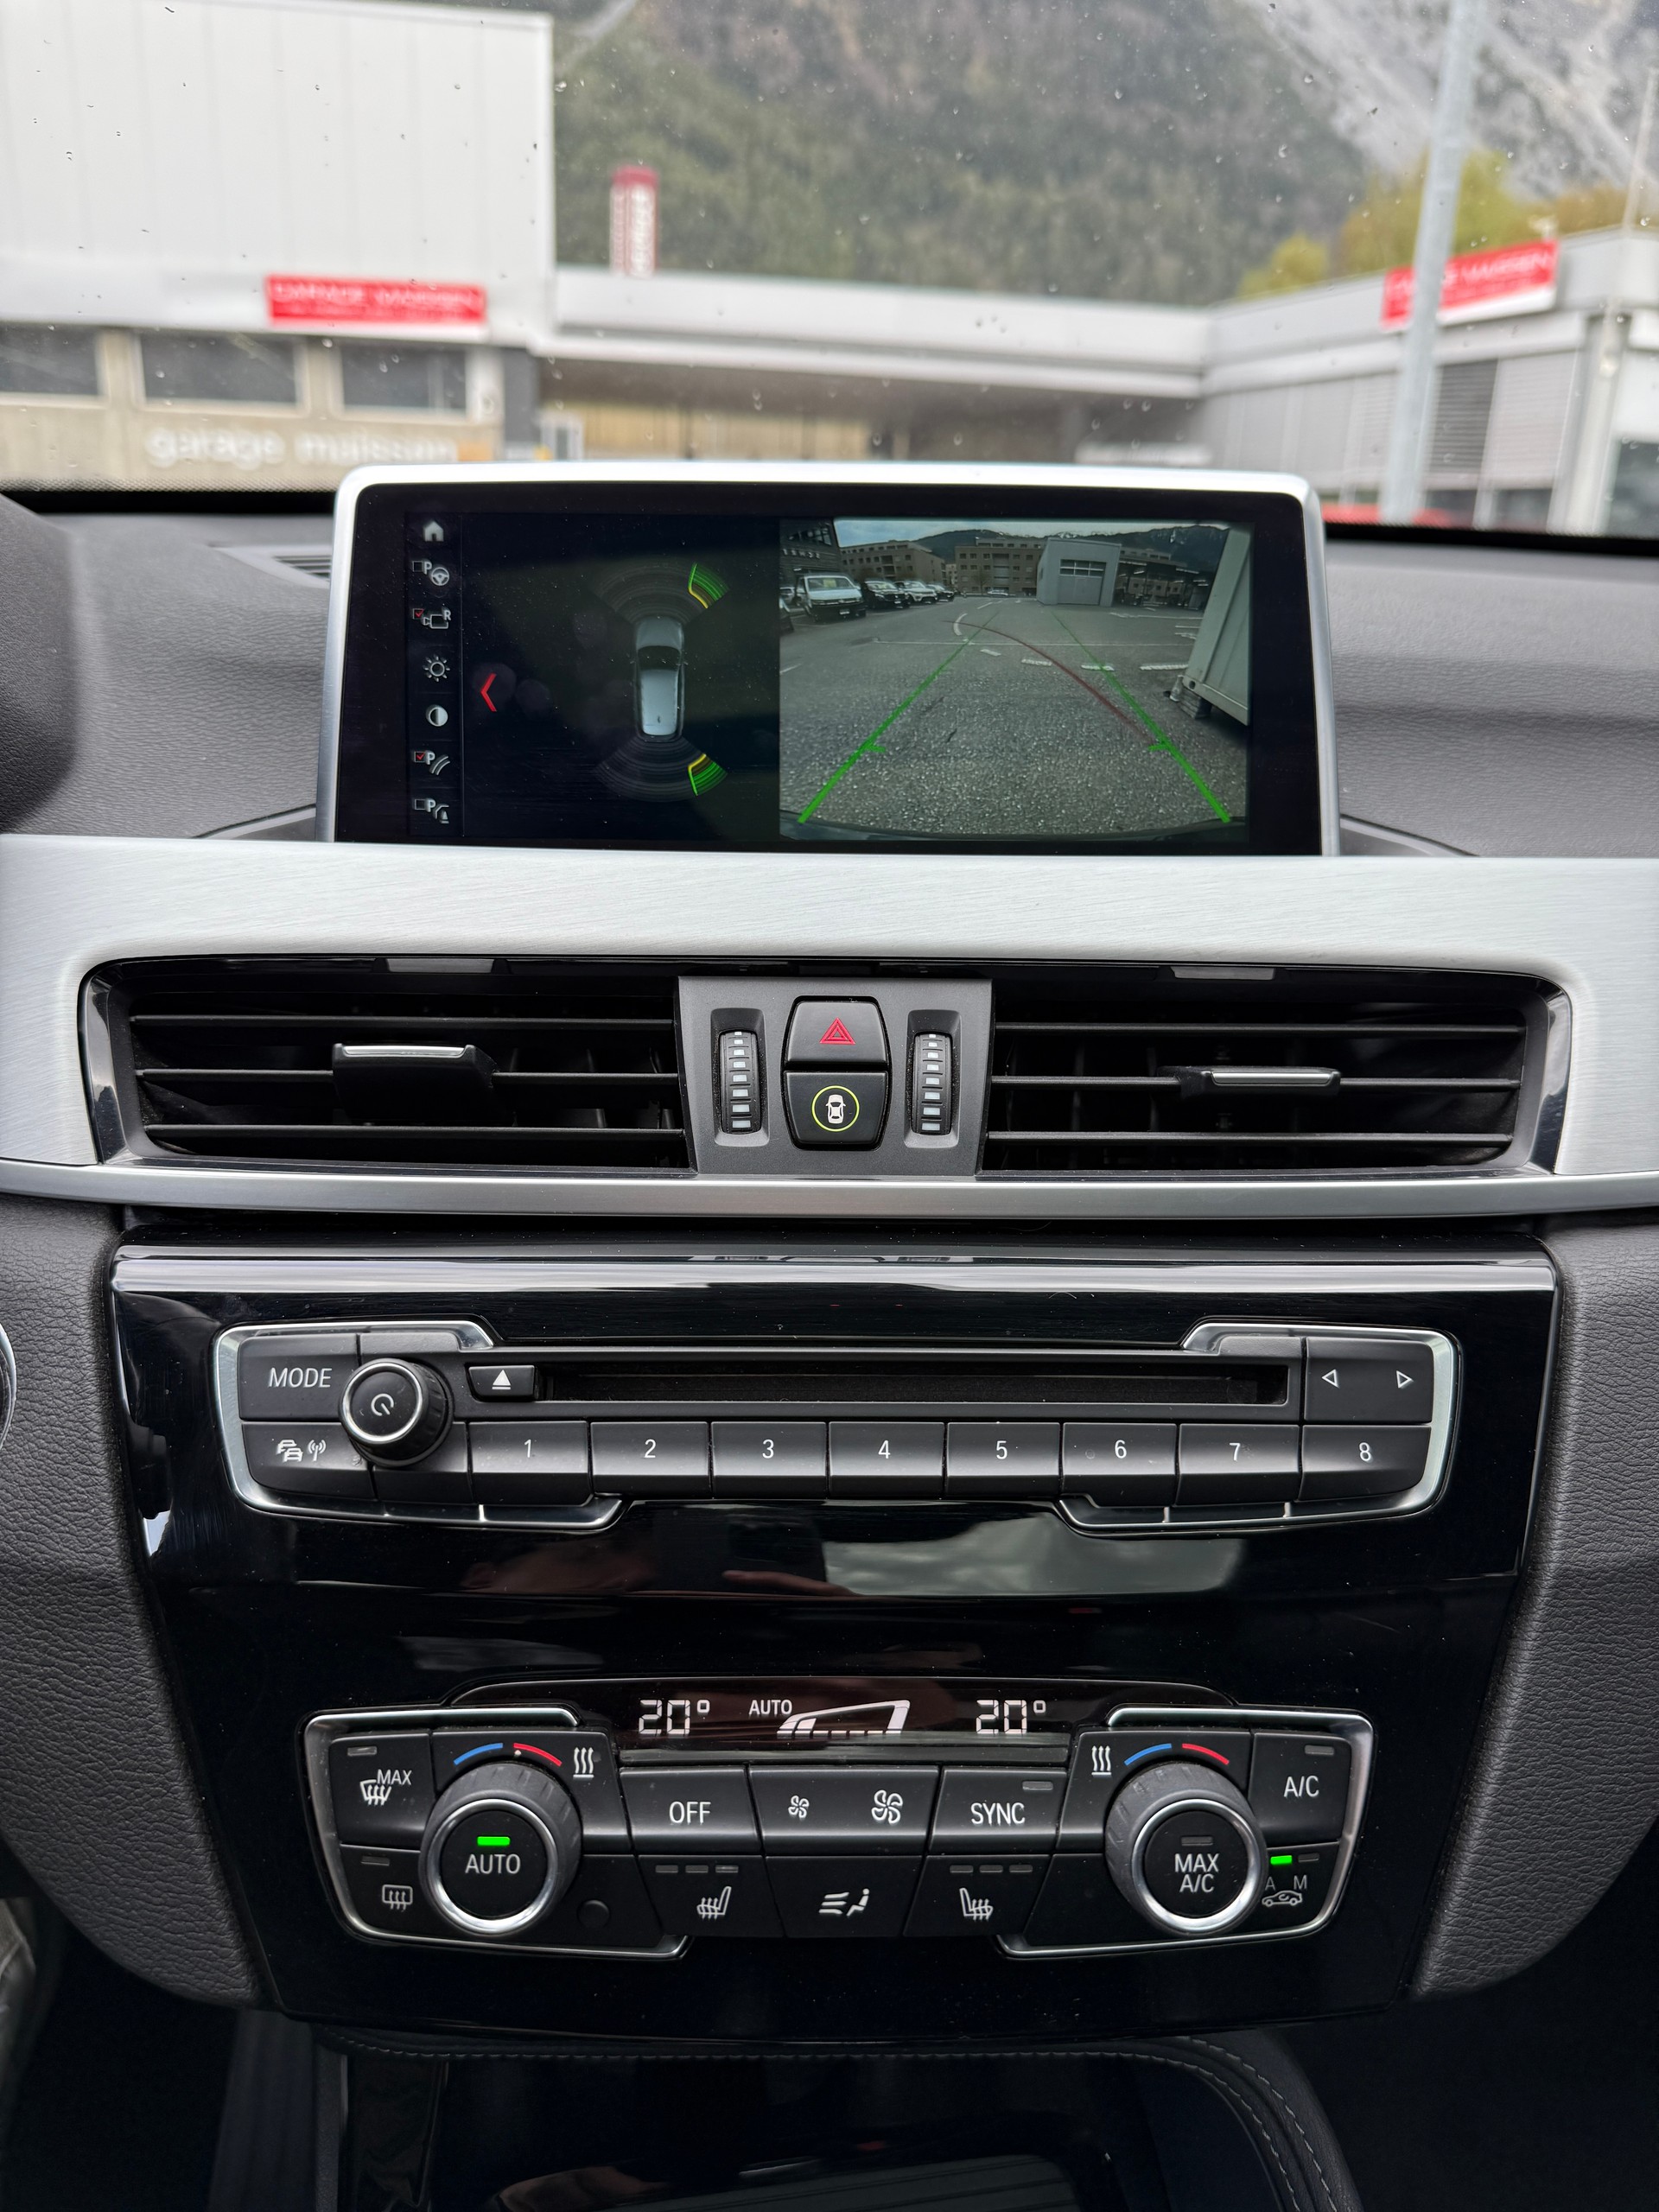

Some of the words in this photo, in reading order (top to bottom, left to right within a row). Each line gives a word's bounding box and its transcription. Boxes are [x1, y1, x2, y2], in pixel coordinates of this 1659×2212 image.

[144, 428, 285, 471] garage
[268, 1367, 333, 1389] MODE
[524, 1439, 532, 1459] 1
[644, 1439, 657, 1459] 2
[762, 1439, 774, 1459] 3
[878, 1440, 891, 1459] 4
[996, 1440, 1007, 1460] 5
[1115, 1439, 1128, 1459] 6
[1229, 1442, 1241, 1462] 7
[1359, 1441, 1372, 1462] 8
[638, 1699, 710, 1735] 20°
[748, 1699, 793, 1716] AUTO
[976, 1699, 1046, 1734] 20°
[376, 1769, 412, 1786] MAX
[1283, 1775, 1320, 1798] A/C
[669, 1801, 711, 1825] OFF
[970, 1801, 1026, 1826] SYNC
[465, 1853, 521, 1875] AUTO
[1174, 1853, 1219, 1873] MAX
[1179, 1873, 1214, 1893] A/C
[1264, 1876, 1276, 1891] A
[1294, 1874, 1308, 1890] M
